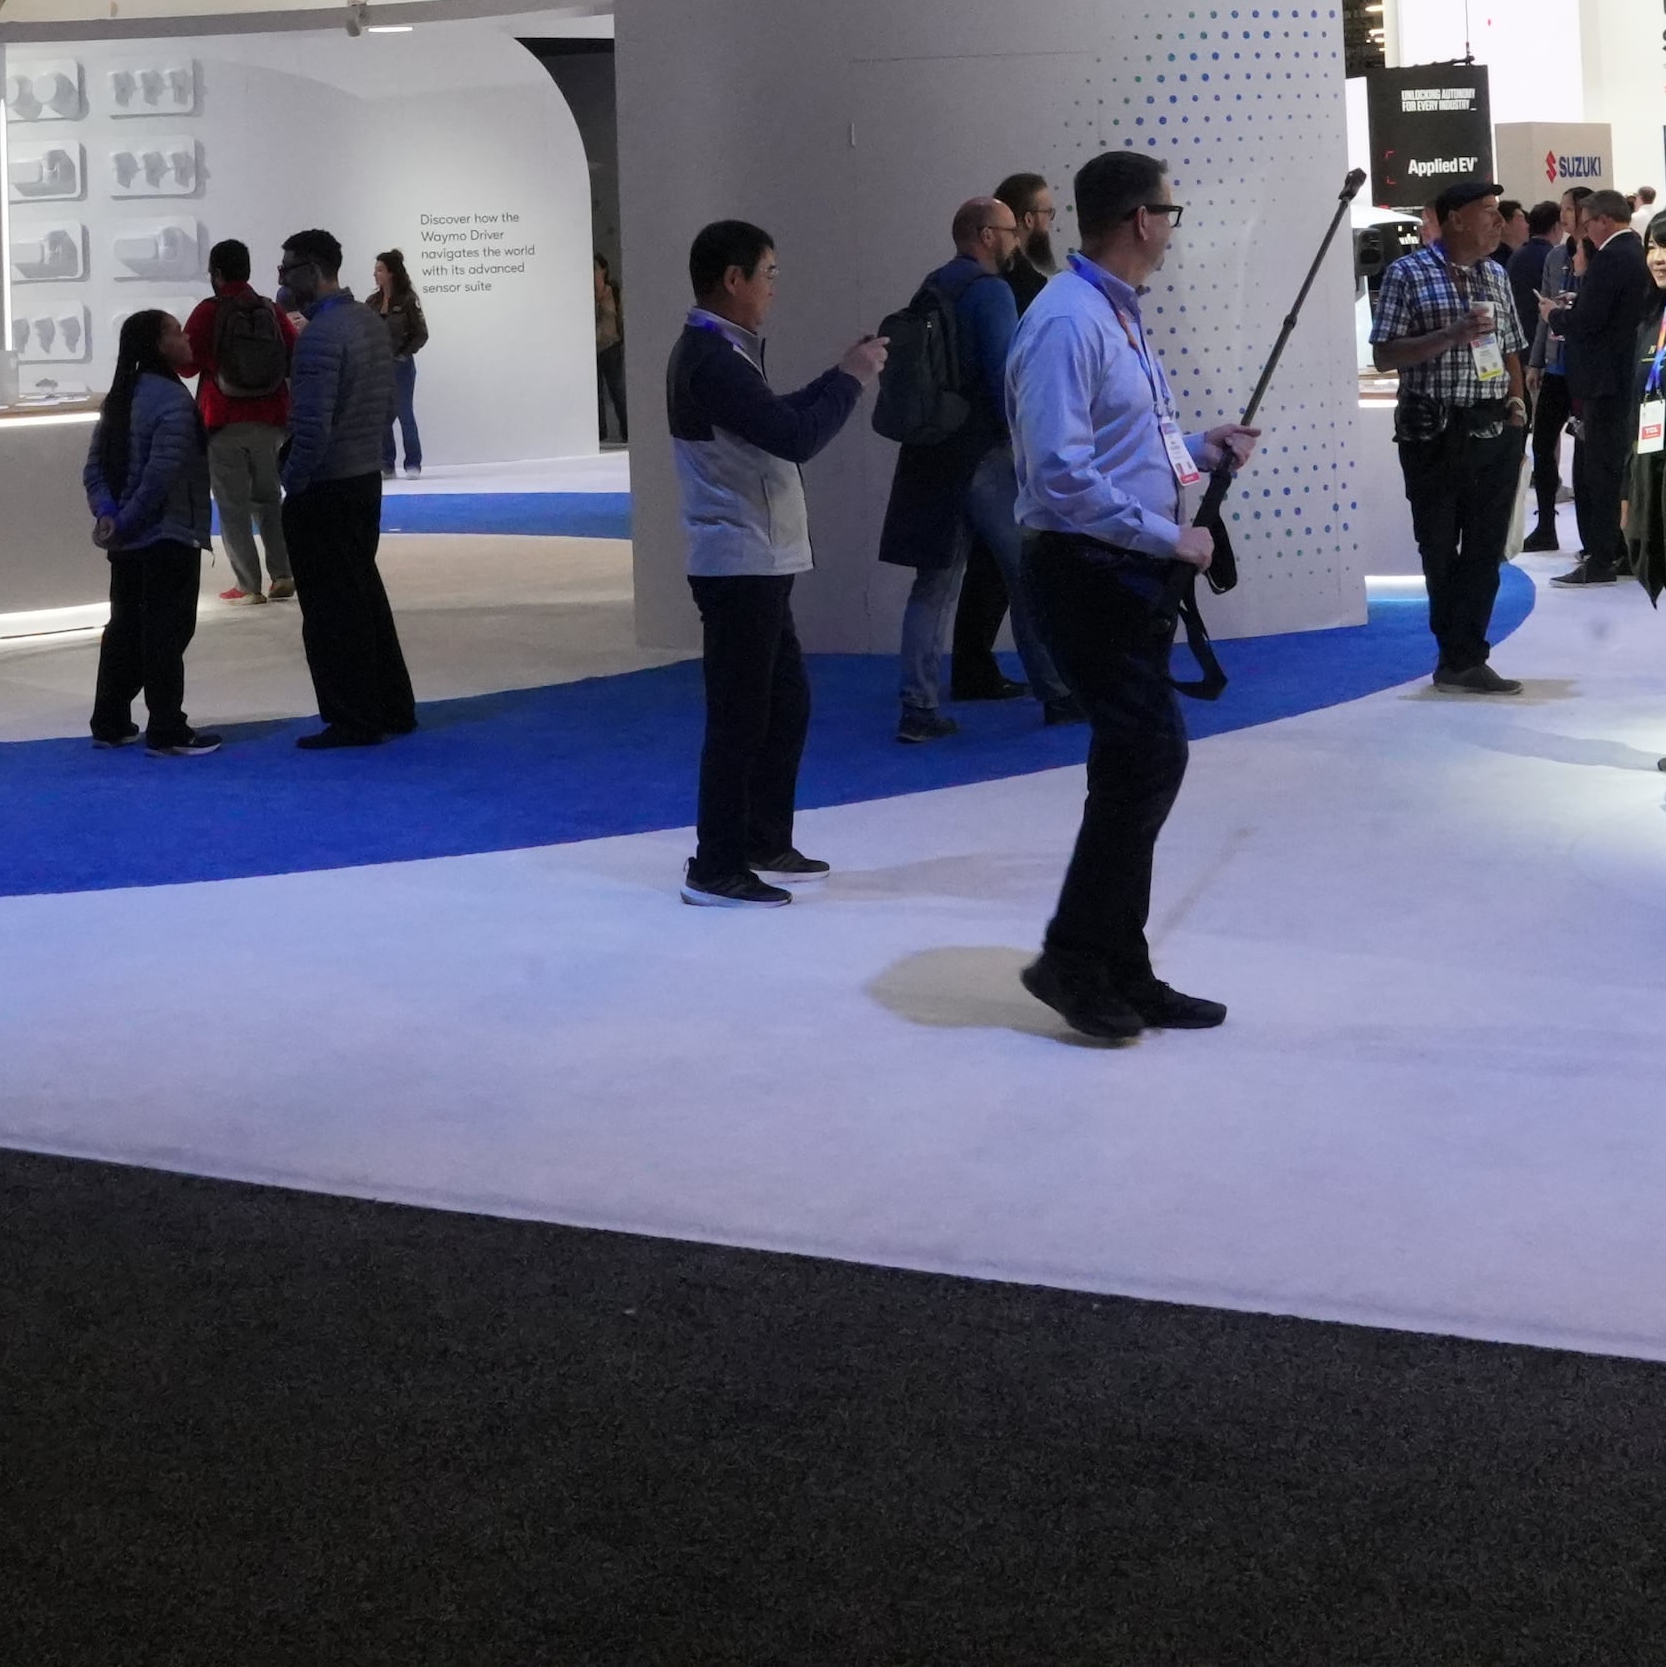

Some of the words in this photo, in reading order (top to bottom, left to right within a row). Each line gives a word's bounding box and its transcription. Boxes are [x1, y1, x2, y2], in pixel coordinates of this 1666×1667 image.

[1402, 100, 1417, 112] FOR
[1417, 100, 1439, 112] EVERY
[1408, 157, 1458, 177] Applied
[1559, 156, 1601, 178] SUZUKI
[421, 214, 471, 225] Discover
[475, 213, 498, 224] how
[502, 212, 519, 222] the
[421, 231, 467, 244] Waymo
[471, 230, 504, 240] Driver
[421, 248, 479, 262] navigates
[483, 246, 501, 257] the
[504, 244, 535, 256] world
[422, 265, 448, 276] with
[451, 264, 465, 276] its
[469, 262, 525, 274] advanced
[423, 284, 461, 294] sensor
[465, 281, 492, 292] suite
